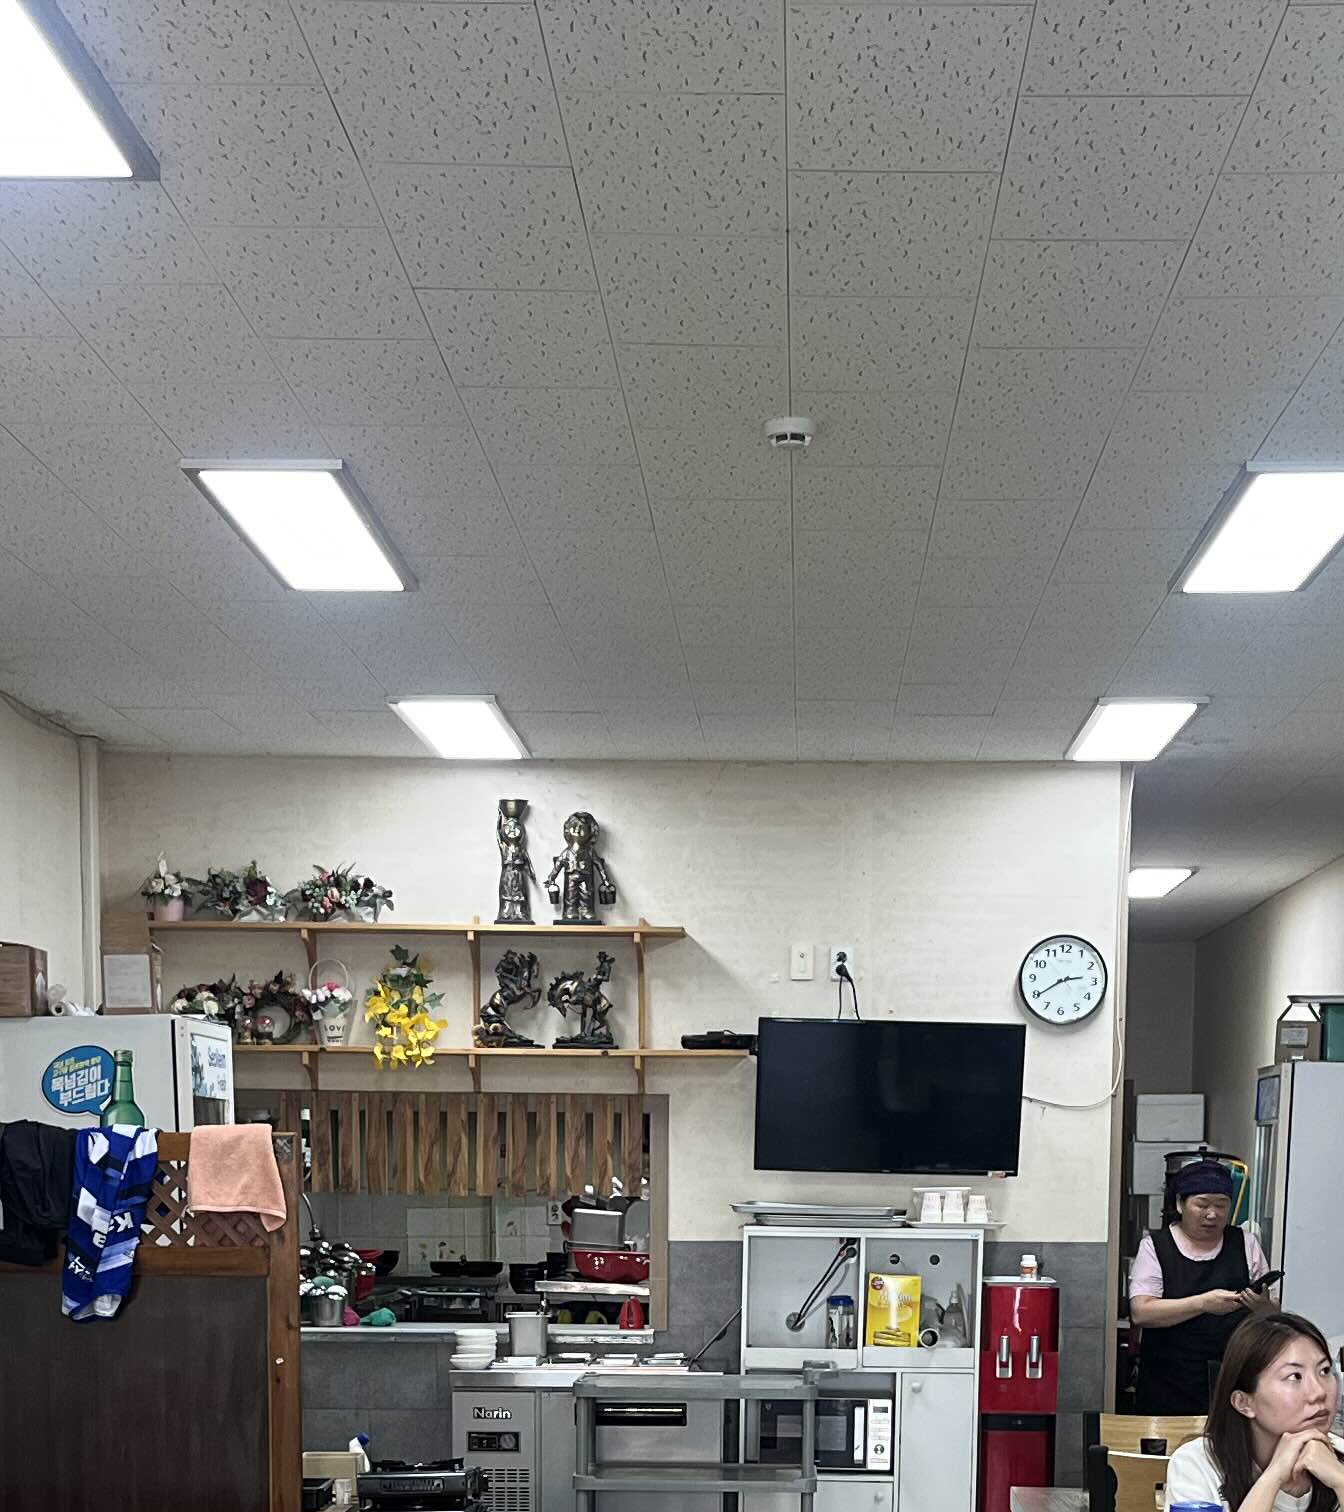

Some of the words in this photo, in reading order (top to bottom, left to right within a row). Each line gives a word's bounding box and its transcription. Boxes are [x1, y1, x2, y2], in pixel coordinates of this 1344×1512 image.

[1045, 948, 1056, 957] 11
[1059, 945, 1072, 953] 12
[1079, 949, 1083, 958] 1
[1034, 960, 1047, 969] 10
[1087, 962, 1094, 970] 2
[1029, 974, 1036, 982] 9
[1091, 977, 1097, 986] 3
[1032, 990, 1040, 999] 8
[1084, 992, 1090, 1001] 4
[1044, 1002, 1050, 1010] 7
[1073, 1003, 1080, 1012] 5
[1057, 1007, 1064, 1015] 6
[474, 1407, 511, 1419] Narin
